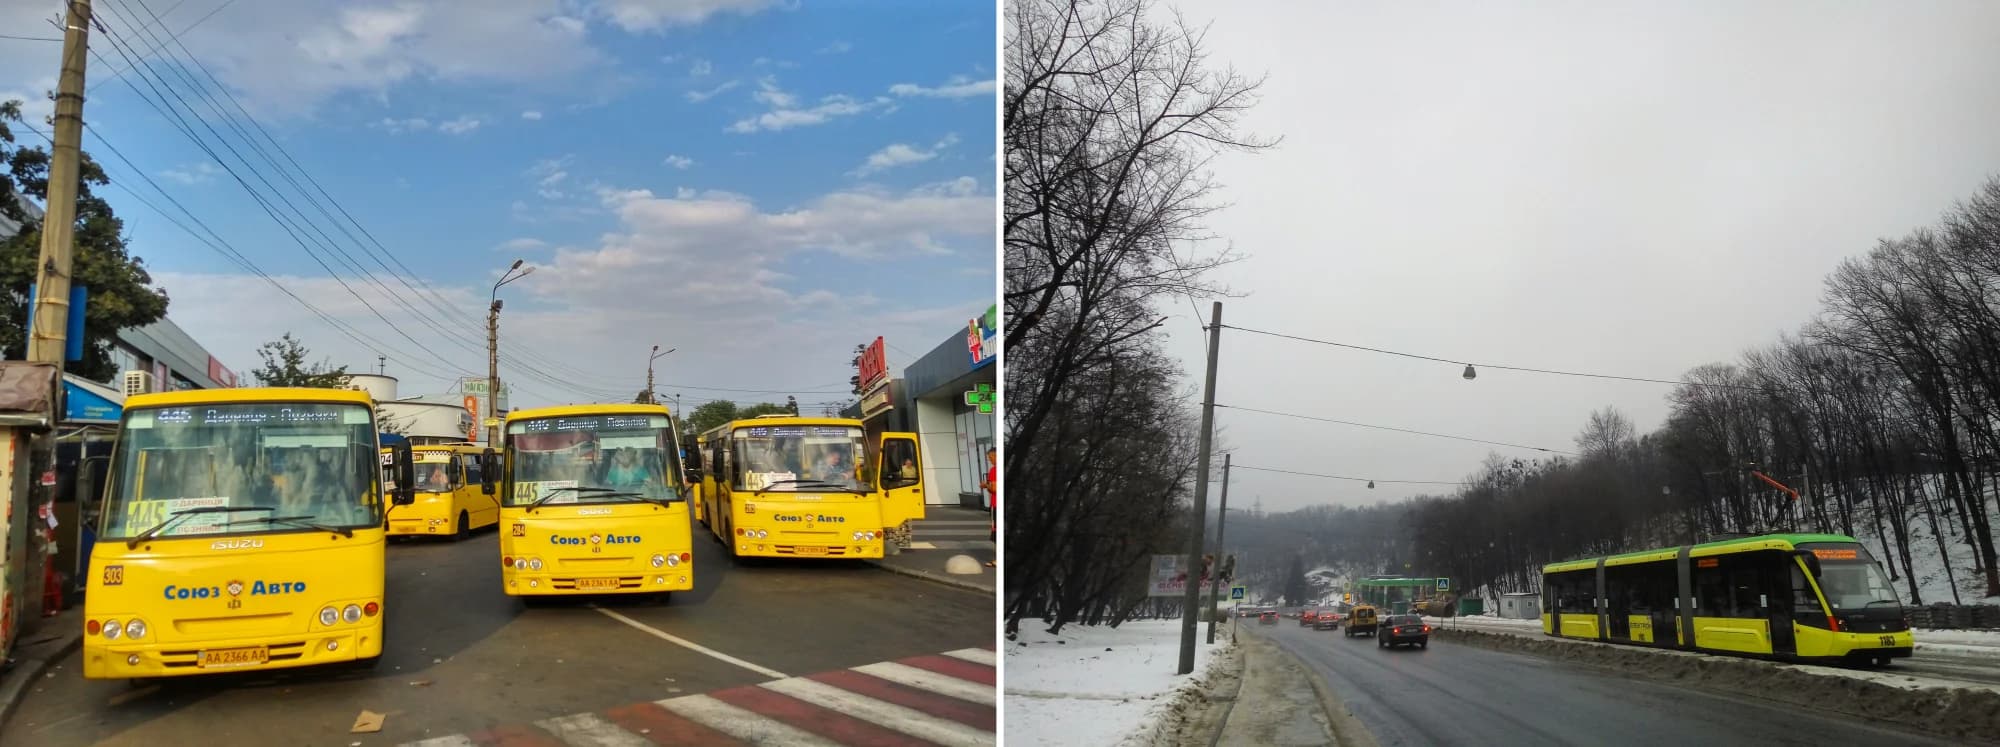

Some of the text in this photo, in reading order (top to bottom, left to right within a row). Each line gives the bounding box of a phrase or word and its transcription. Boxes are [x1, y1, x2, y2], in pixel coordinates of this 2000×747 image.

[515, 482, 538, 503] 445
[129, 501, 164, 531] 445
[774, 513, 845, 523] Союз Авто
[550, 533, 641, 545] Союз Авто
[103, 566, 123, 584] 303
[164, 580, 306, 600] Союз Авто
[223, 650, 248, 662] 2366
